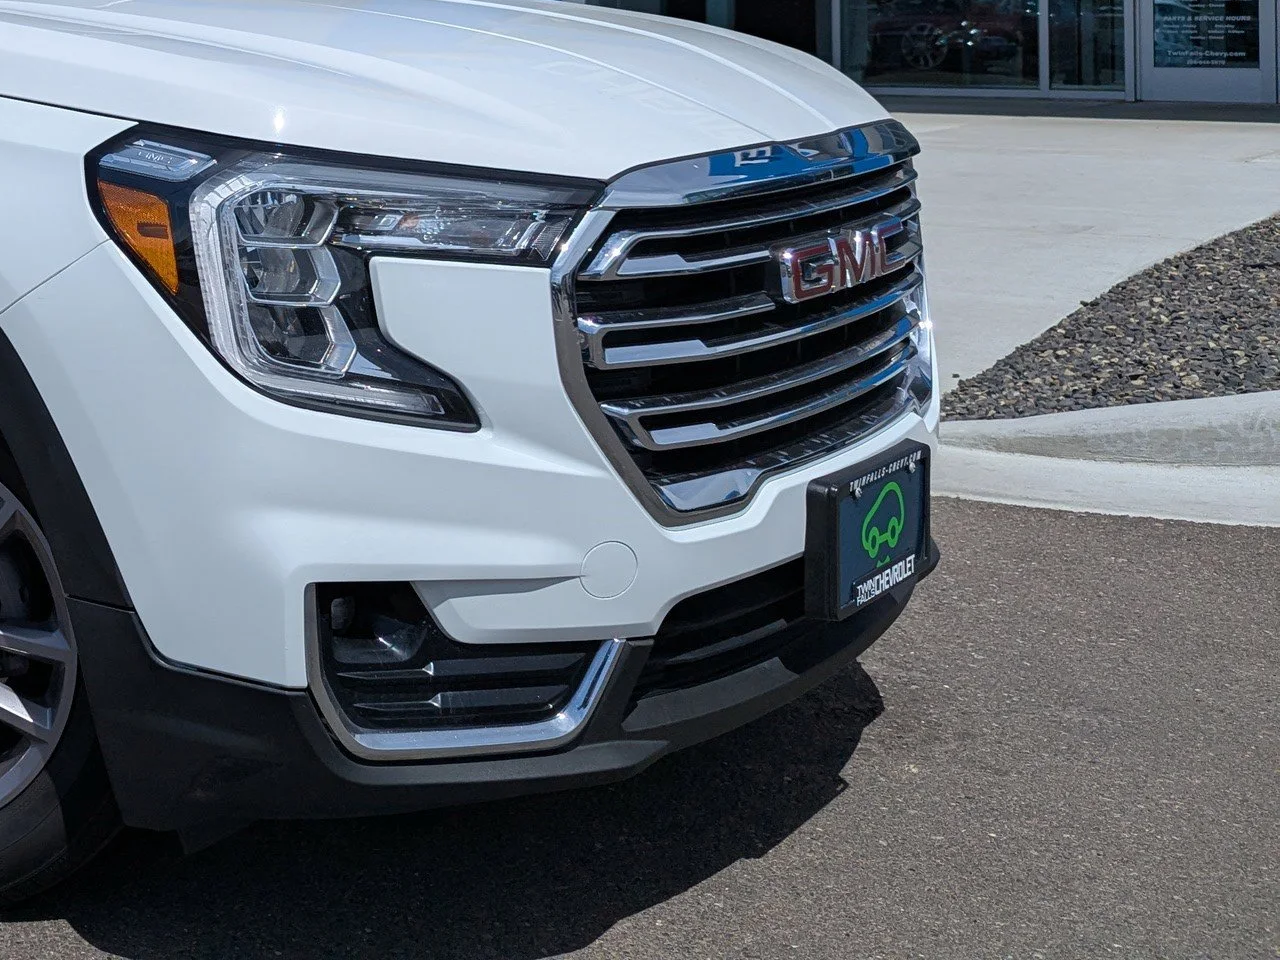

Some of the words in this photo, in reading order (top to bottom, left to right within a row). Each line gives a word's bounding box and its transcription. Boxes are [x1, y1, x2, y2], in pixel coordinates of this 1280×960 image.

[780, 217, 910, 304] GMC
[856, 578, 875, 596] TWIN
[874, 554, 915, 595] CHEVROLET
[856, 588, 876, 607] FALLS
